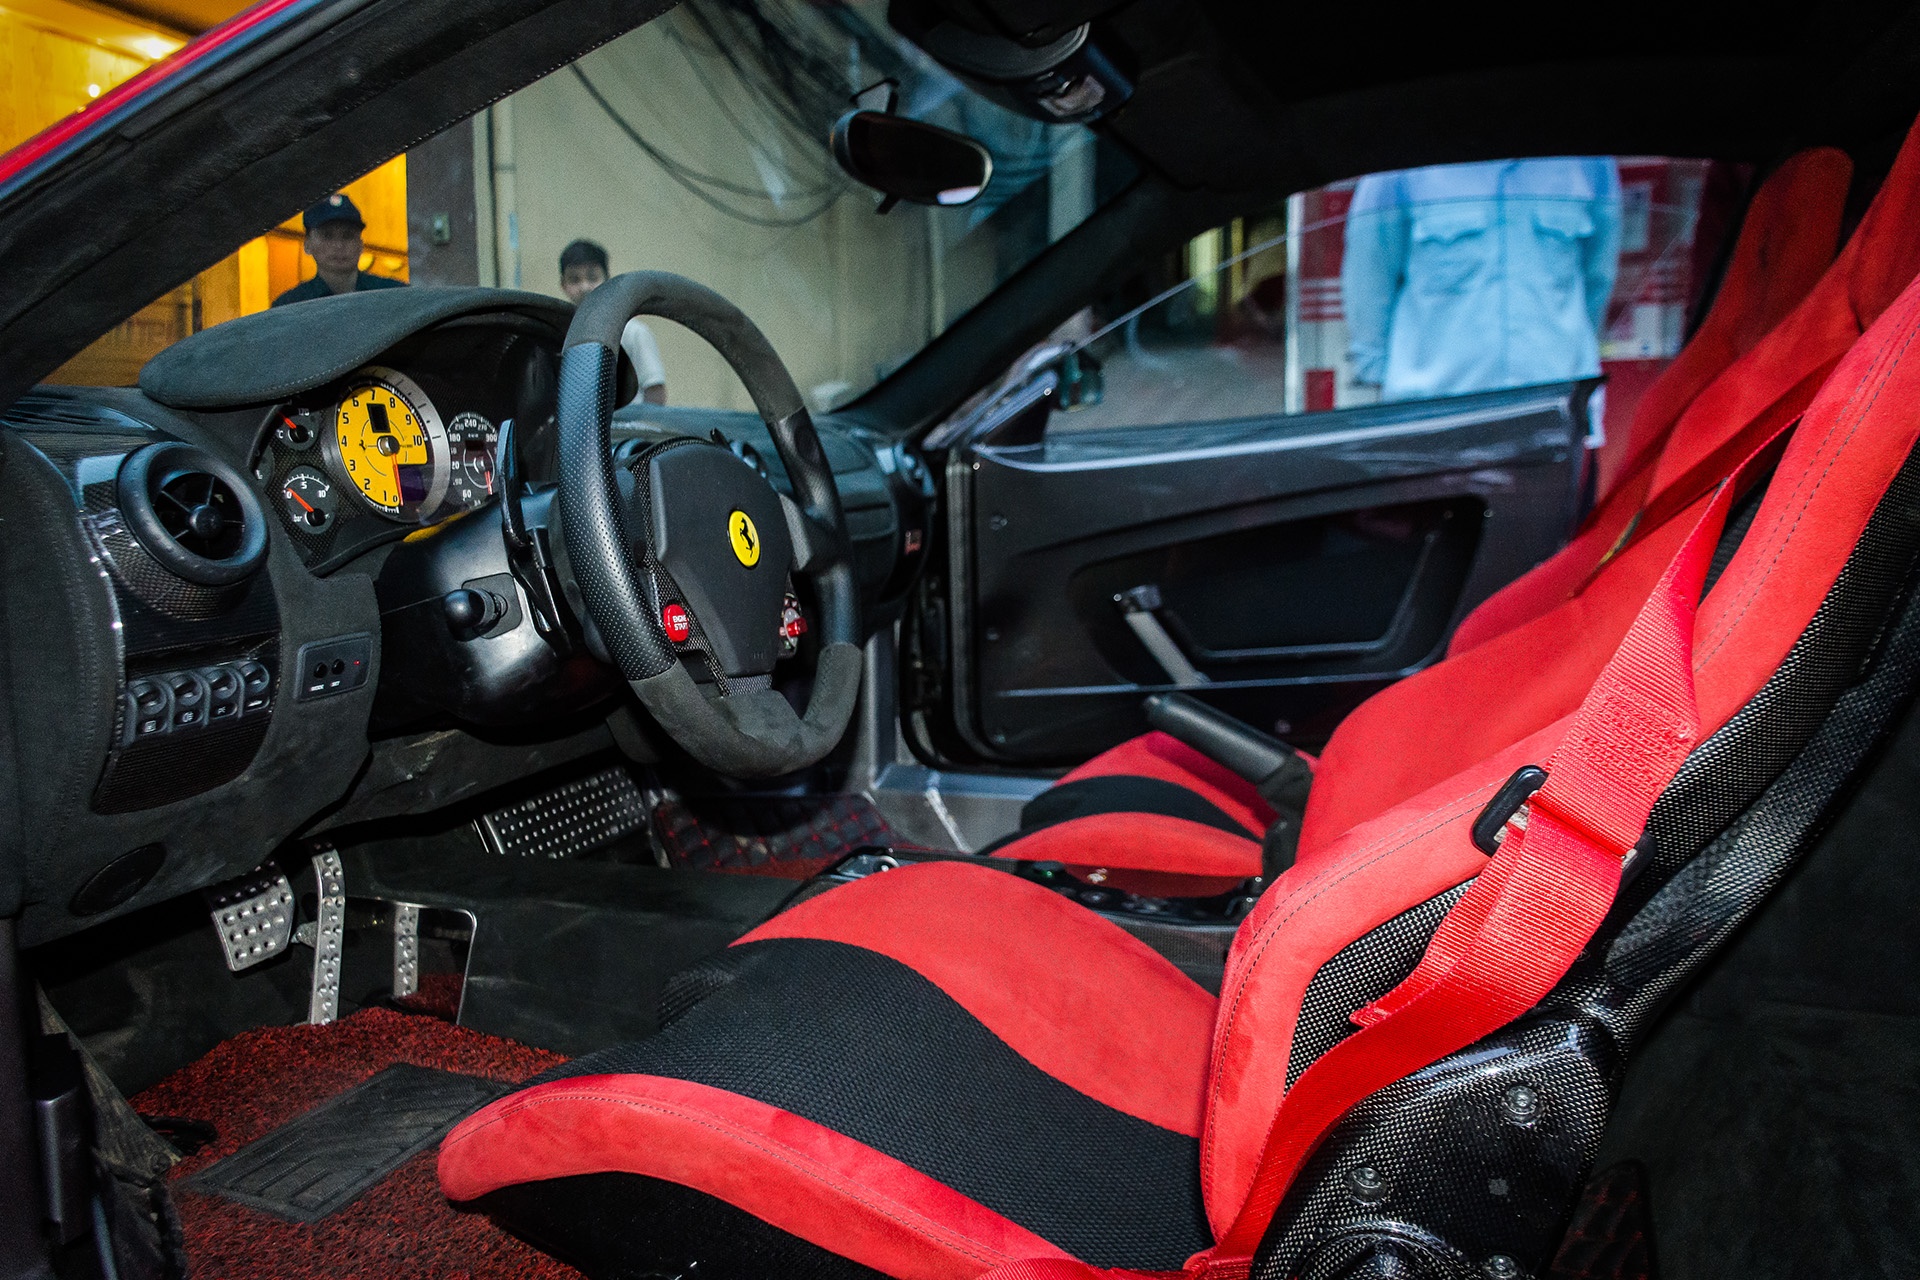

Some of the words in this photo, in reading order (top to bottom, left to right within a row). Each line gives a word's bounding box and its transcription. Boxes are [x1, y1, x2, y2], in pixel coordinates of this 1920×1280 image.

[371, 389, 376, 400] 7
[352, 397, 360, 407] 6
[389, 397, 396, 408] 8
[342, 412, 350, 424] 5
[405, 414, 412, 425] 9
[464, 418, 477, 428] 240
[341, 436, 348, 447] 4
[413, 435, 423, 446] 10
[349, 459, 356, 472] 3
[364, 478, 371, 490] 2
[318, 490, 326, 498] 10
[672, 614, 687, 623] ENGINE
[674, 622, 689, 631] START
